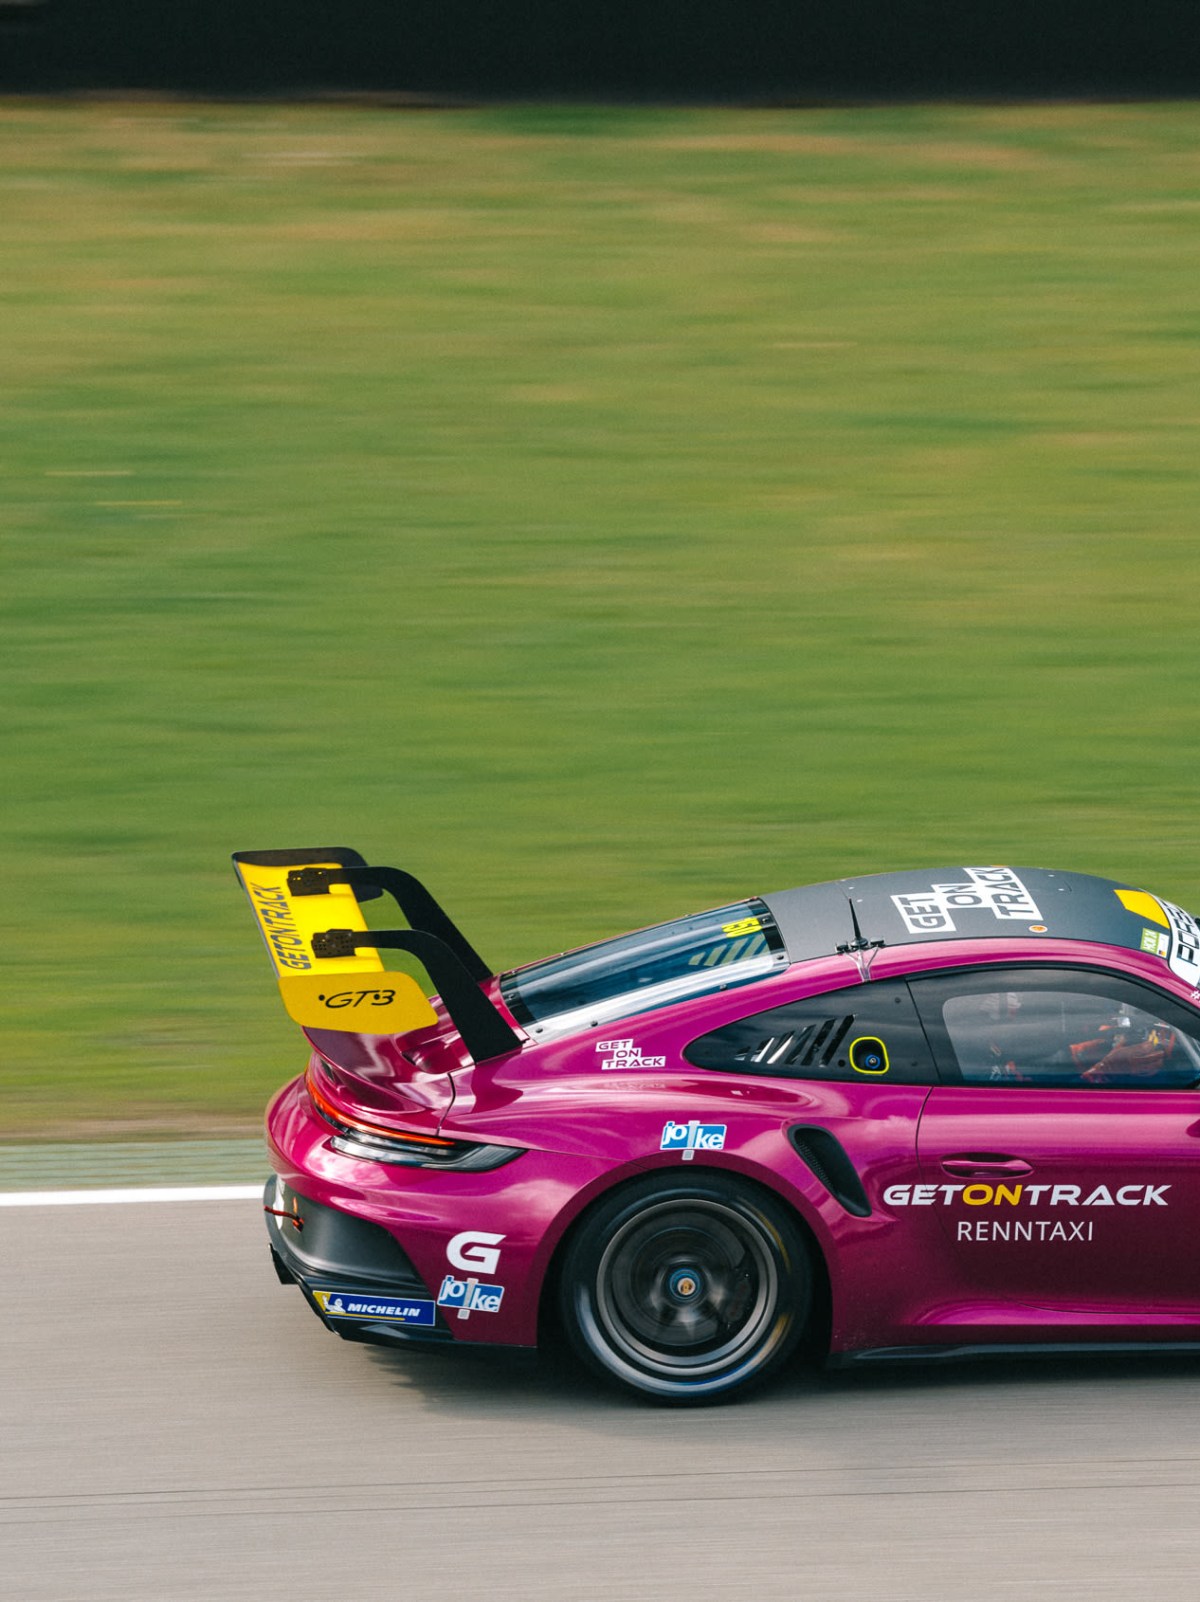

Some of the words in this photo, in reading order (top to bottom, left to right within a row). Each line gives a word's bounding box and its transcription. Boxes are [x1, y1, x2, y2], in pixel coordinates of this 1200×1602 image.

[938, 885, 983, 906] ON
[970, 867, 1034, 917] TRACK
[897, 896, 947, 930] GET
[250, 883, 312, 971] GETONTRACK
[325, 989, 396, 1009] GT3
[598, 1039, 632, 1050] GET
[616, 1049, 640, 1058] ON
[605, 1057, 664, 1069] TRACK
[883, 1184, 1172, 1206] GETONTRACK
[957, 1221, 1094, 1242] RENNTAXI
[347, 1302, 421, 1317] MICHELIN
